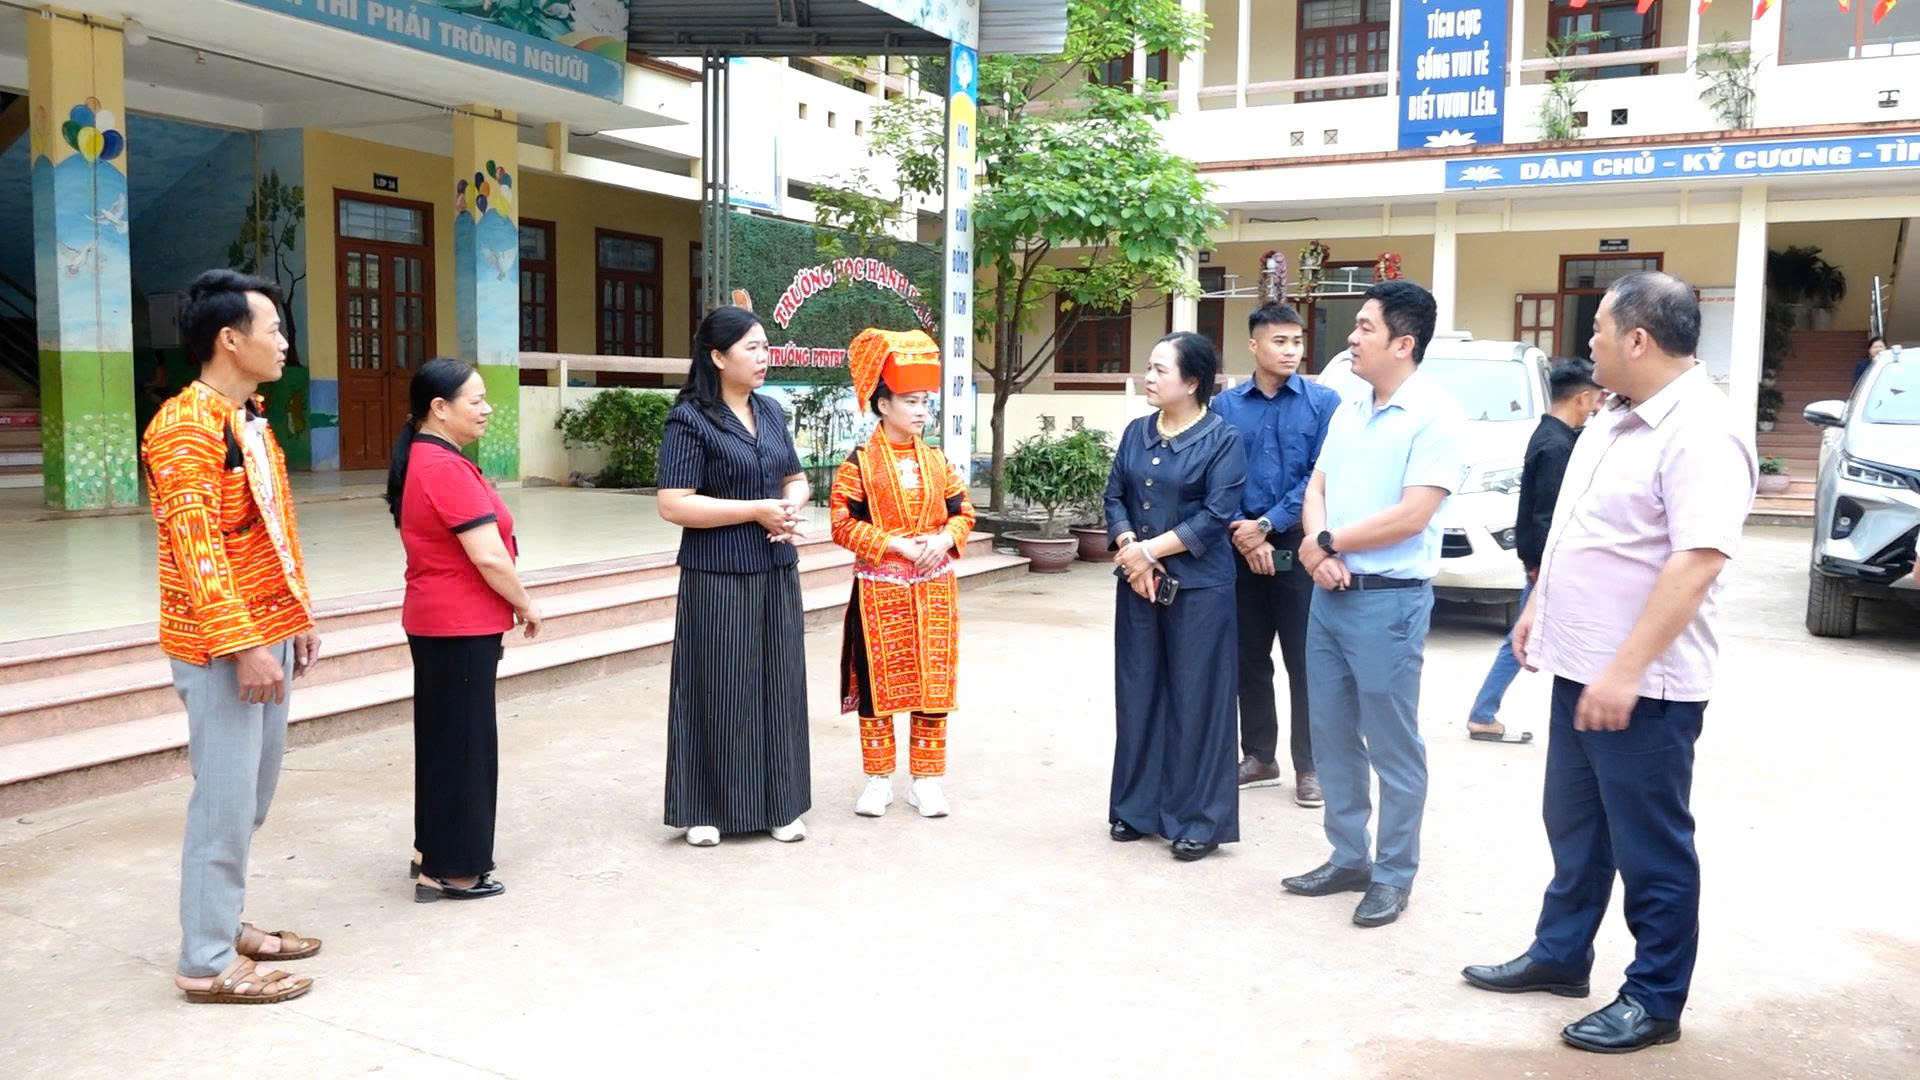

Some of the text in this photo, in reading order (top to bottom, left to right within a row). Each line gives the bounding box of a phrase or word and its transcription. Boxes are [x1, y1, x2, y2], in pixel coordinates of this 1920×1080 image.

[367, 0, 430, 41] PHẢI
[524, 45, 589, 84] NGƯỜI
[1451, 51, 1472, 77] VUI
[1520, 158, 1583, 180] DÂN
[1592, 150, 1655, 176] CHỦ
[1683, 145, 1726, 172] KỶ
[1735, 145, 1852, 170] CƯƠNG
[773, 265, 833, 329] TRƯỜNG
[865, 257, 908, 298] HẠNH
